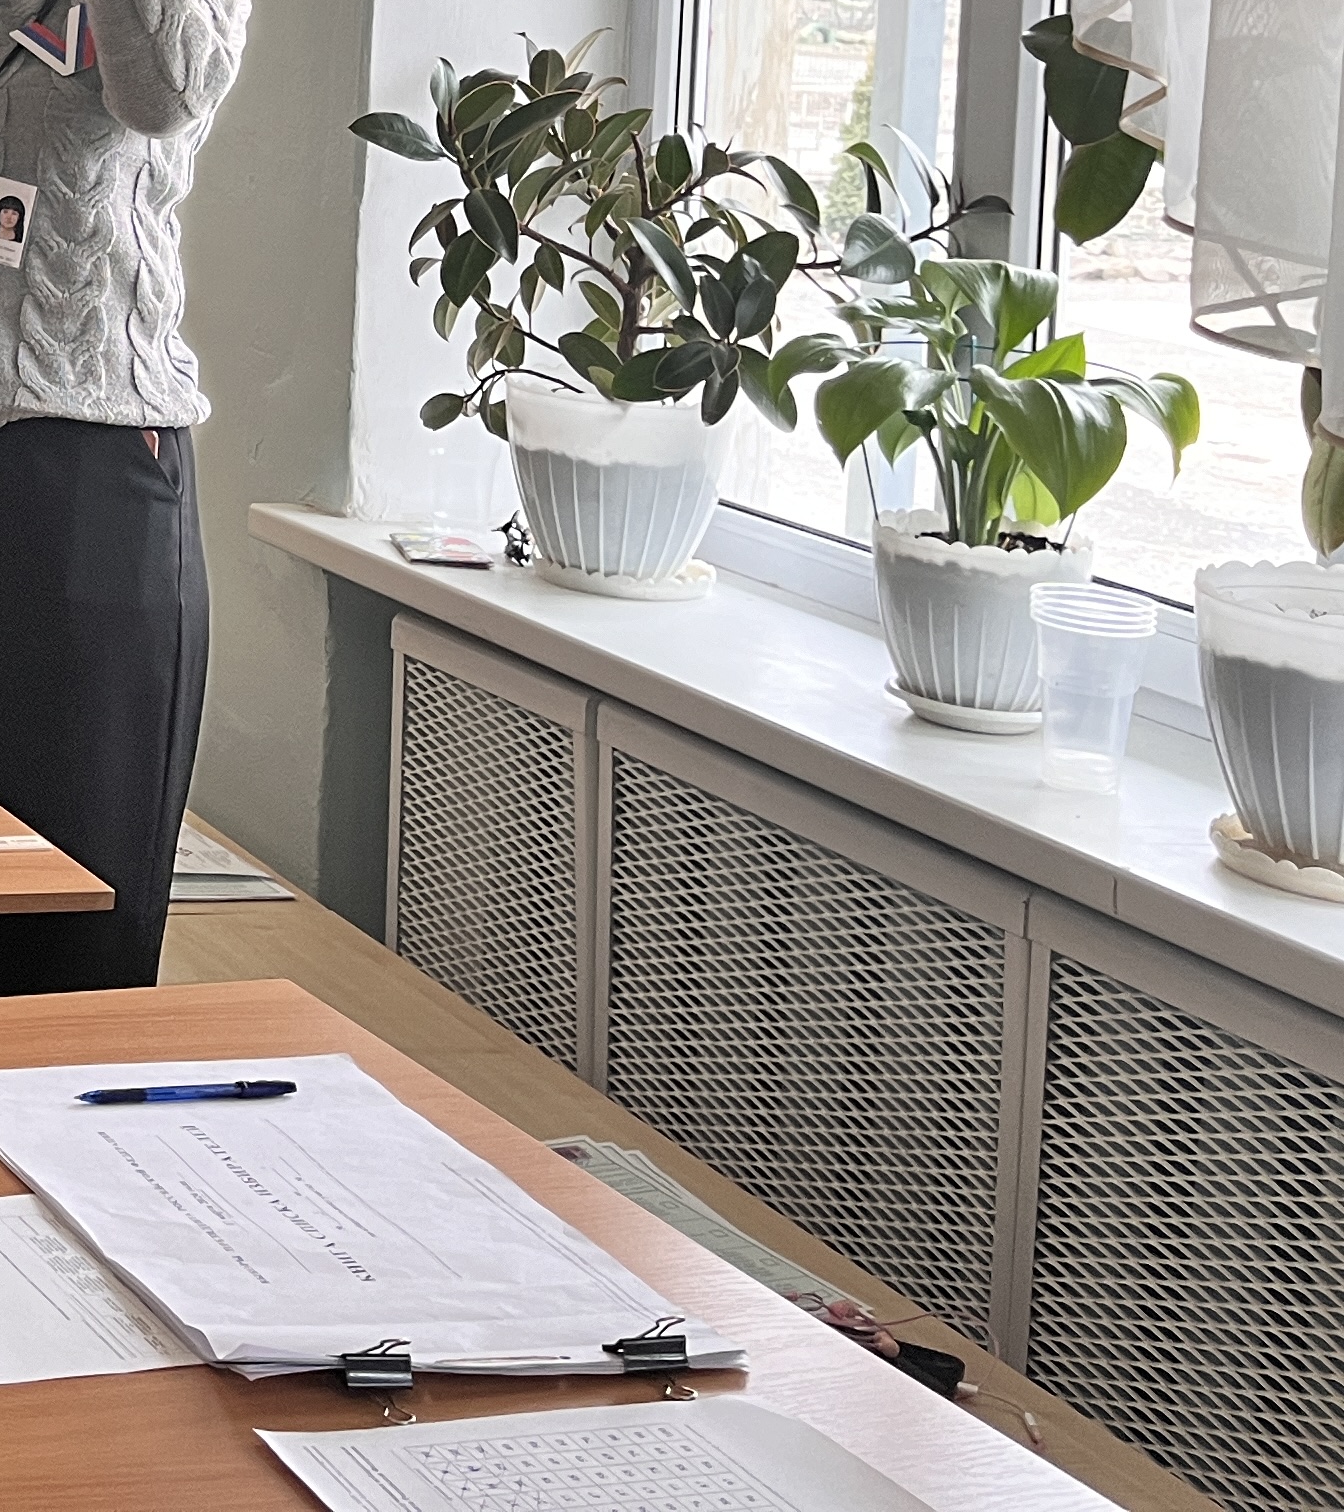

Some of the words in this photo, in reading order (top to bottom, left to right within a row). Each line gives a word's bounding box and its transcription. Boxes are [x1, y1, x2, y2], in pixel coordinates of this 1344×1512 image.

[178, 1124, 271, 1199] ИЗБИРАТЕЛЕЙ
[268, 1198, 327, 1241] СПИСКА
[325, 1241, 377, 1284] КНИГА
